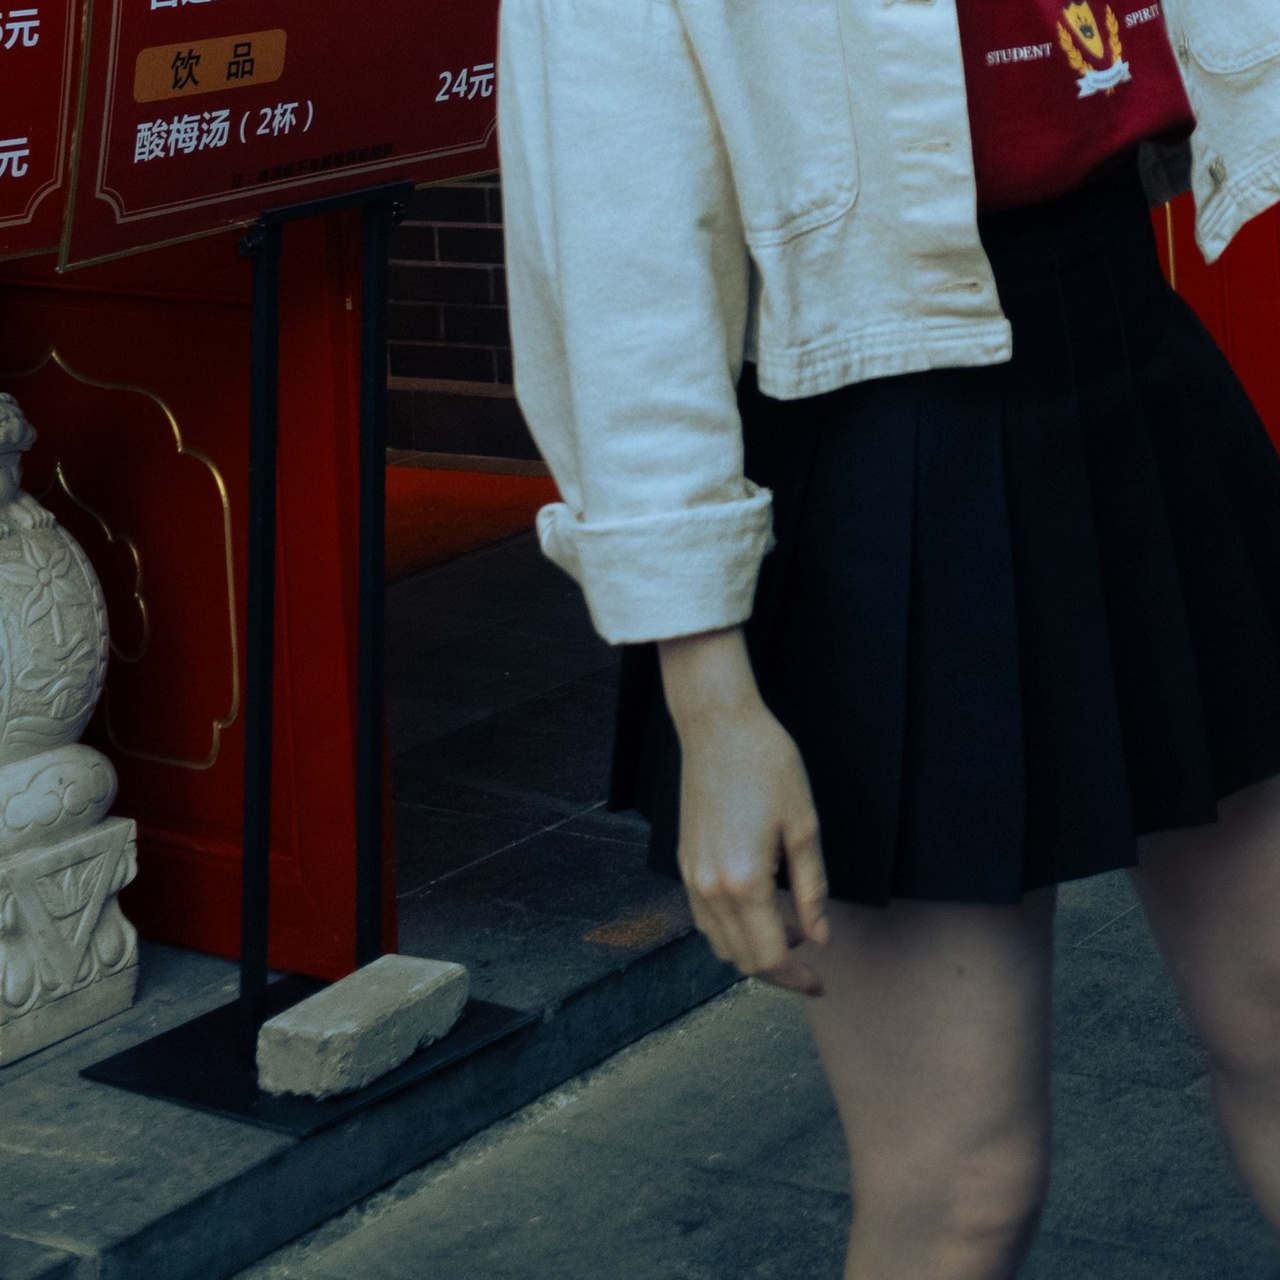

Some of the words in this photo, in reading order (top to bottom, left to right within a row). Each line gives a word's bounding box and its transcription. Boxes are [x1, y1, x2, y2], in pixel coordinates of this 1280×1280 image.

[171, 41, 255, 89] 饮品
[985, 42, 1053, 66] STUDENT
[435, 62, 496, 103] 24元
